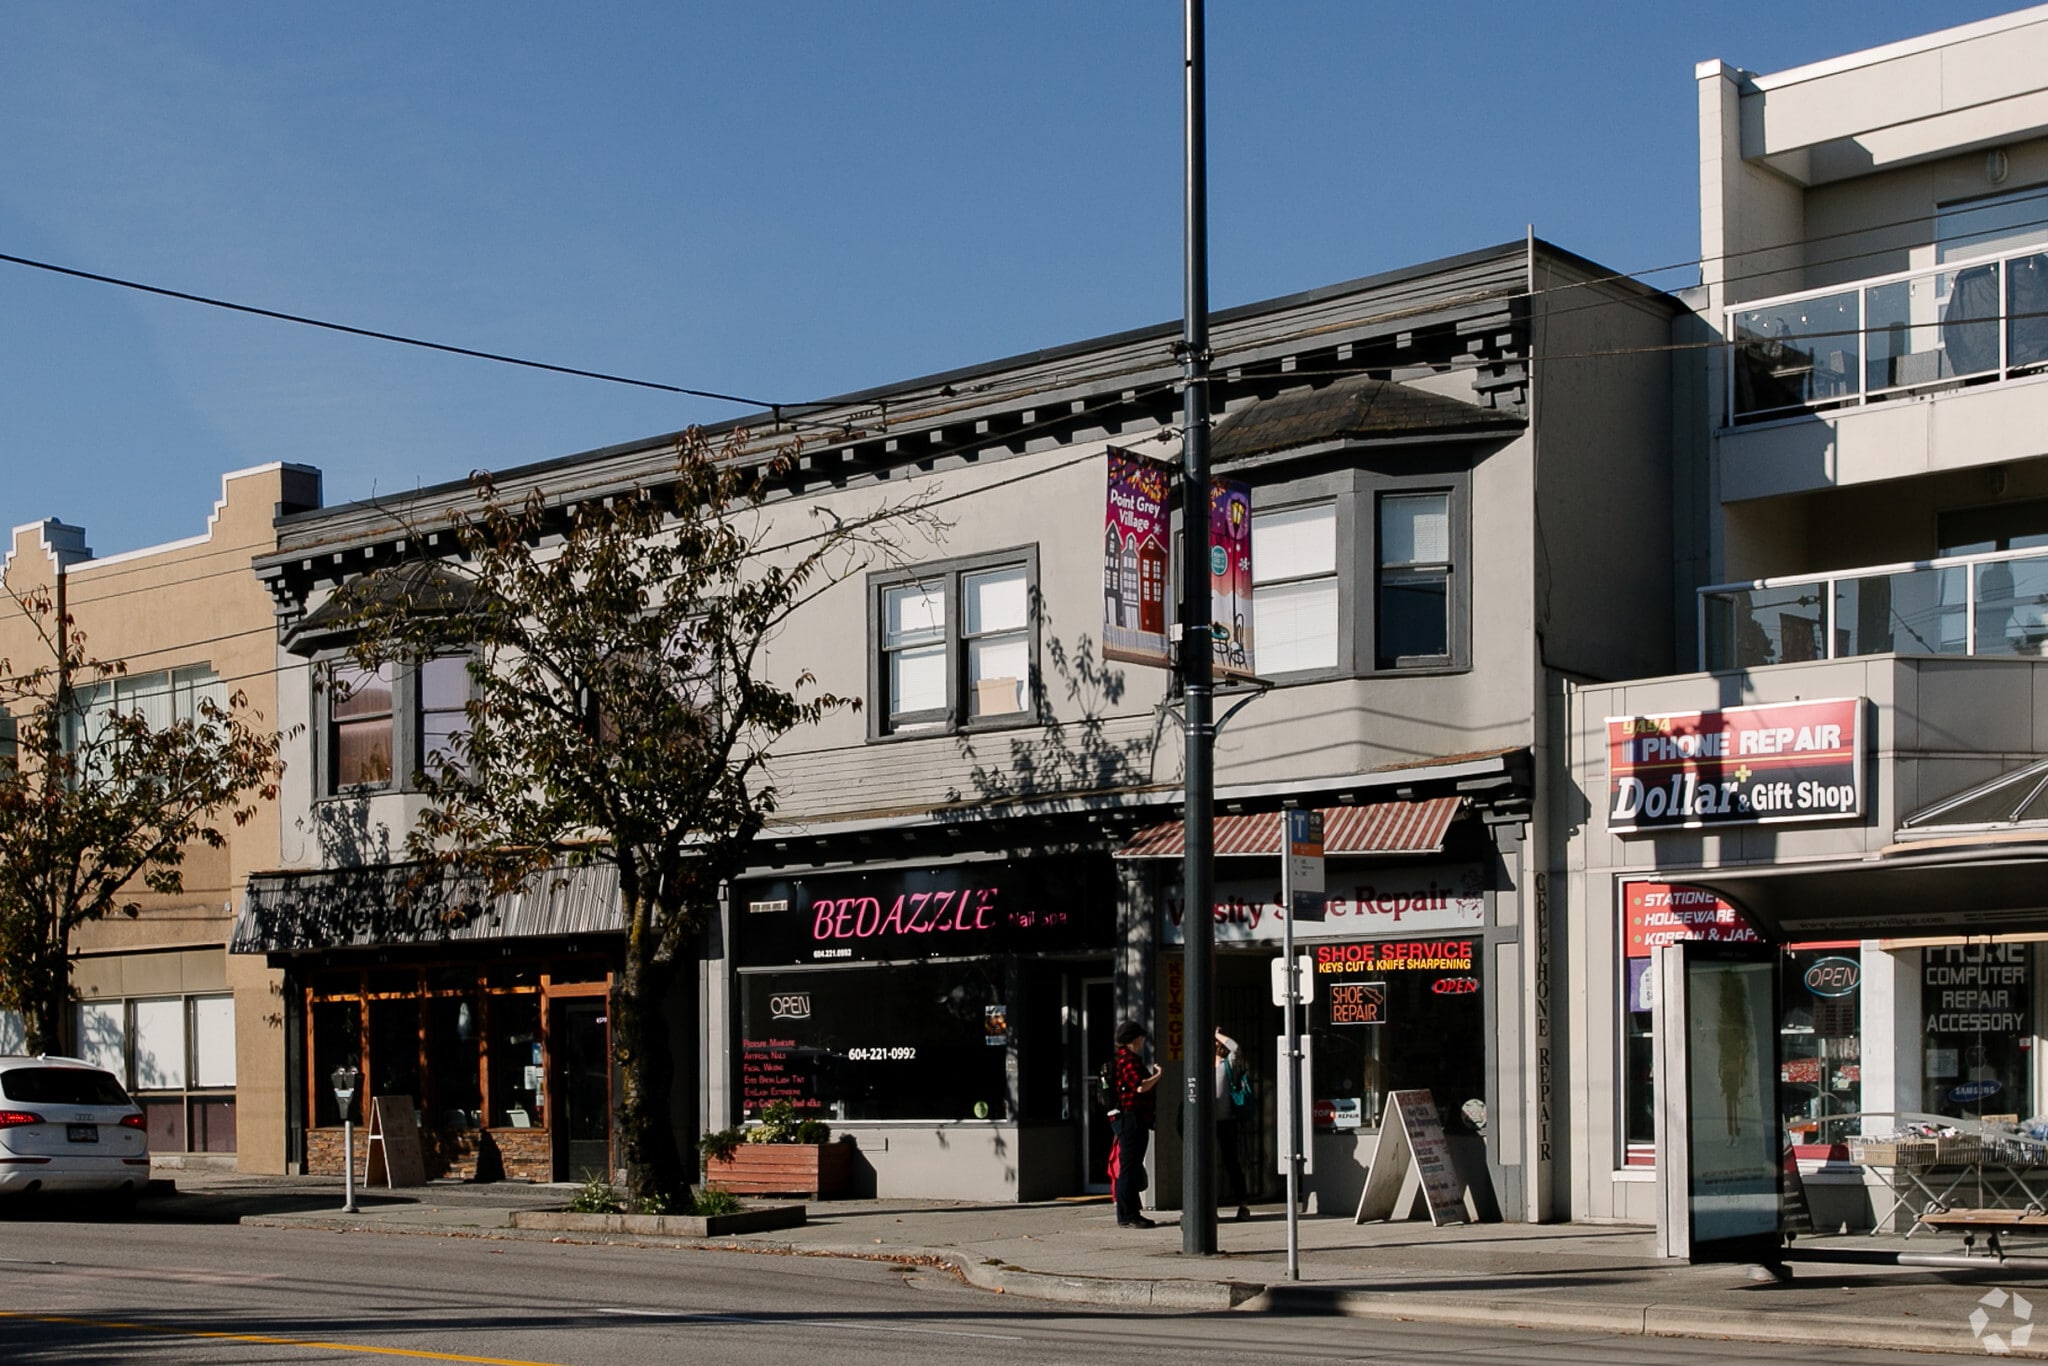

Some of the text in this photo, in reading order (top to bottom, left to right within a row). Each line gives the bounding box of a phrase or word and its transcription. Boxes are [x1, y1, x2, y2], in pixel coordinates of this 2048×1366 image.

[1110, 488, 1160, 519] Point Grey
[1118, 508, 1150, 533] Village
[1642, 724, 1841, 762] PHONE REPAIR
[1610, 771, 1854, 820] Dollar & Gift Shop
[1167, 895, 1265, 930] Vsity
[1354, 881, 1453, 922] Repair
[1644, 891, 1719, 907] STATIONE
[812, 888, 998, 940] BEDAZZLE
[1008, 911, 1035, 928] Nail
[1644, 908, 1736, 926] HOUSEWARE
[1708, 928, 1720, 940] &
[1317, 941, 1472, 963] SHOE SERVICE
[1319, 957, 1472, 973] KEYS CUT & KNIFE SHARPENING
[1432, 978, 1478, 994] OPEN
[1808, 967, 1858, 987] OPEN
[1926, 966, 2025, 986] COMPUTER
[1333, 985, 1364, 1004] SHOE
[1942, 990, 2009, 1009] REPAIR
[771, 996, 810, 1015] OPEN
[1333, 1003, 1378, 1022] REPAIR
[1926, 1012, 2025, 1032] ACCESSORY
[848, 1047, 916, 1060] 604-221-0992
[1539, 1047, 1551, 1162] REPAIR
